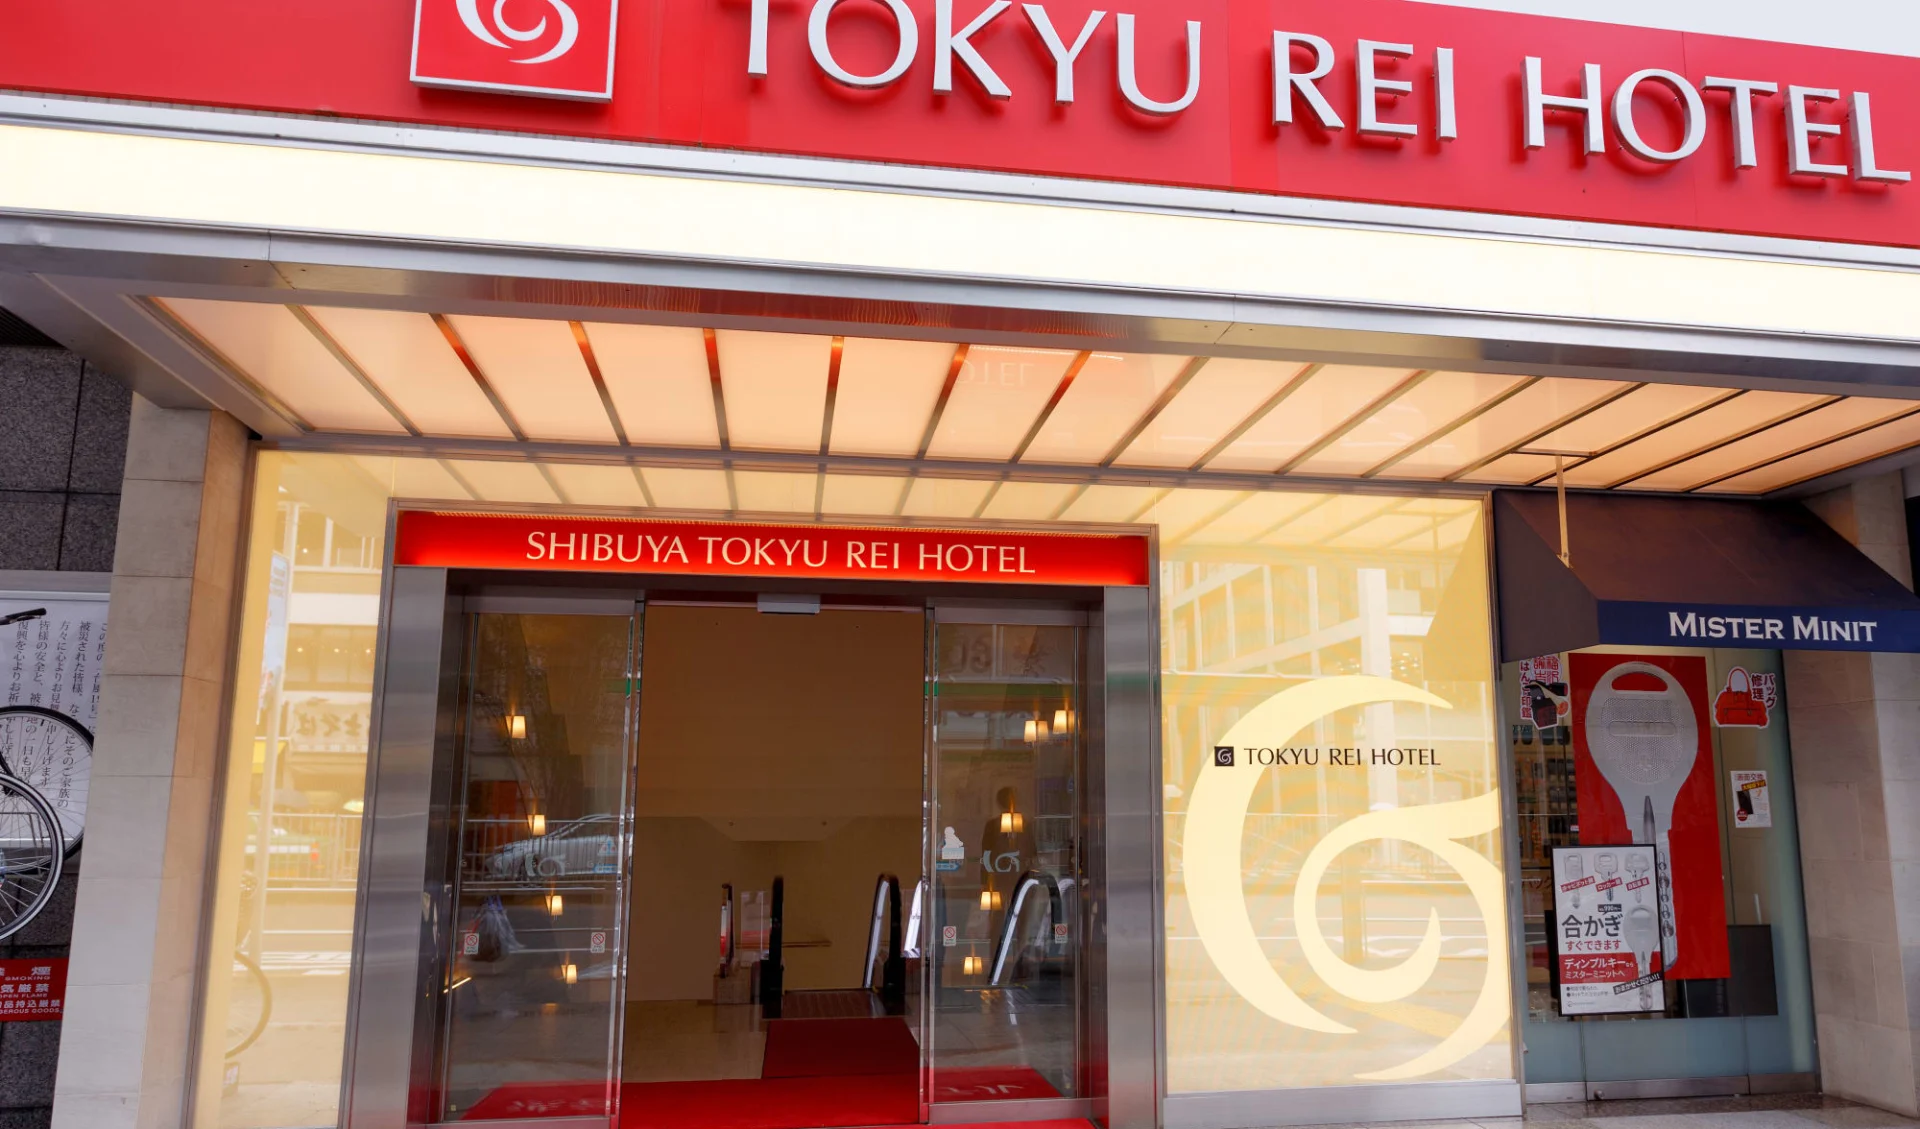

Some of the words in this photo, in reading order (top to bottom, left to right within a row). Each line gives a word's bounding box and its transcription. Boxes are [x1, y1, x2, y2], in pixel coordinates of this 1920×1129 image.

[1272, 29, 1457, 141] REI
[1520, 56, 1911, 186] HOTEL
[526, 531, 690, 564] SHIBUYA
[699, 536, 829, 568] TOKYU
[846, 541, 900, 570] REI
[919, 544, 1036, 574] HOTEL
[1752, 674, 1764, 700] 修理
[1244, 747, 1320, 766] TOKYU
[1330, 748, 1362, 766] REI
[1372, 748, 1442, 766] HOTEL
[1562, 914, 1623, 938] 合かぎ
[1565, 939, 1622, 951] すぐできます
